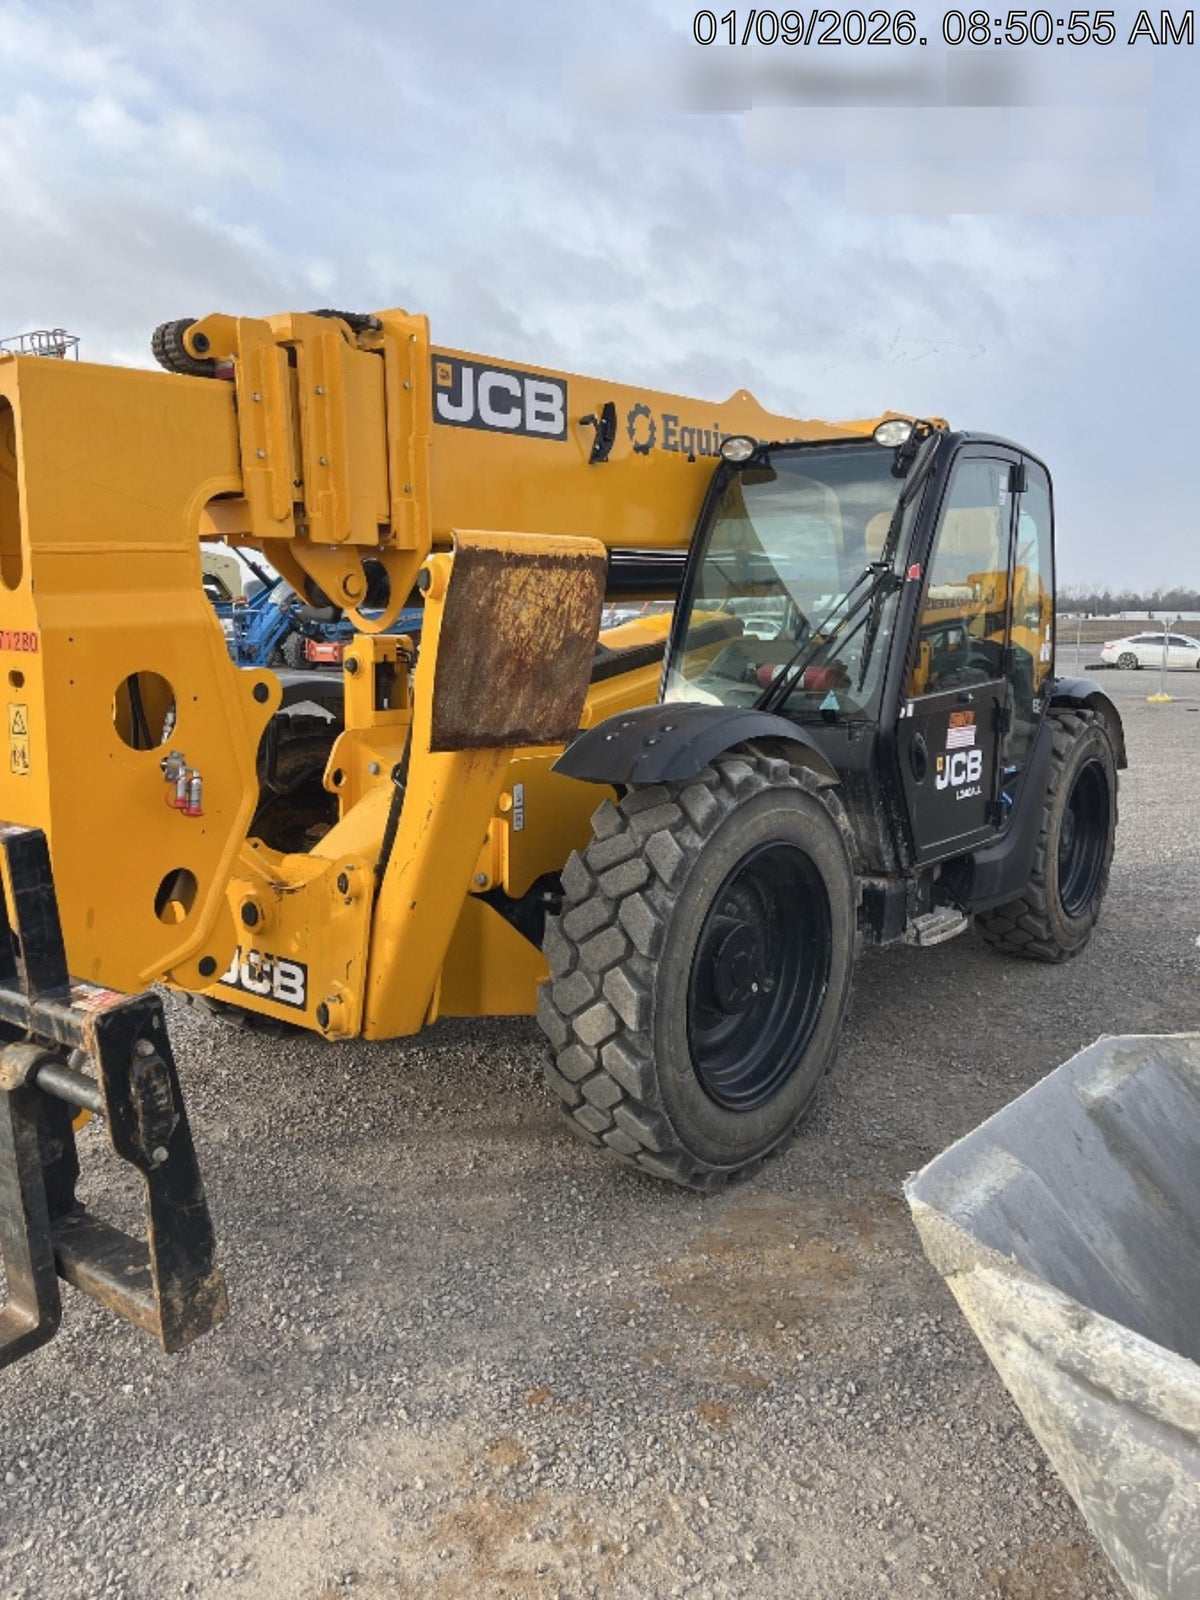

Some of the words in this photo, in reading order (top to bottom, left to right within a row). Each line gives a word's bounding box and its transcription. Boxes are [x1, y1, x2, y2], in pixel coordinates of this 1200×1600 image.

[436, 366, 565, 435] JCB
[935, 749, 983, 791] JCB
[219, 947, 305, 1006] JCB
